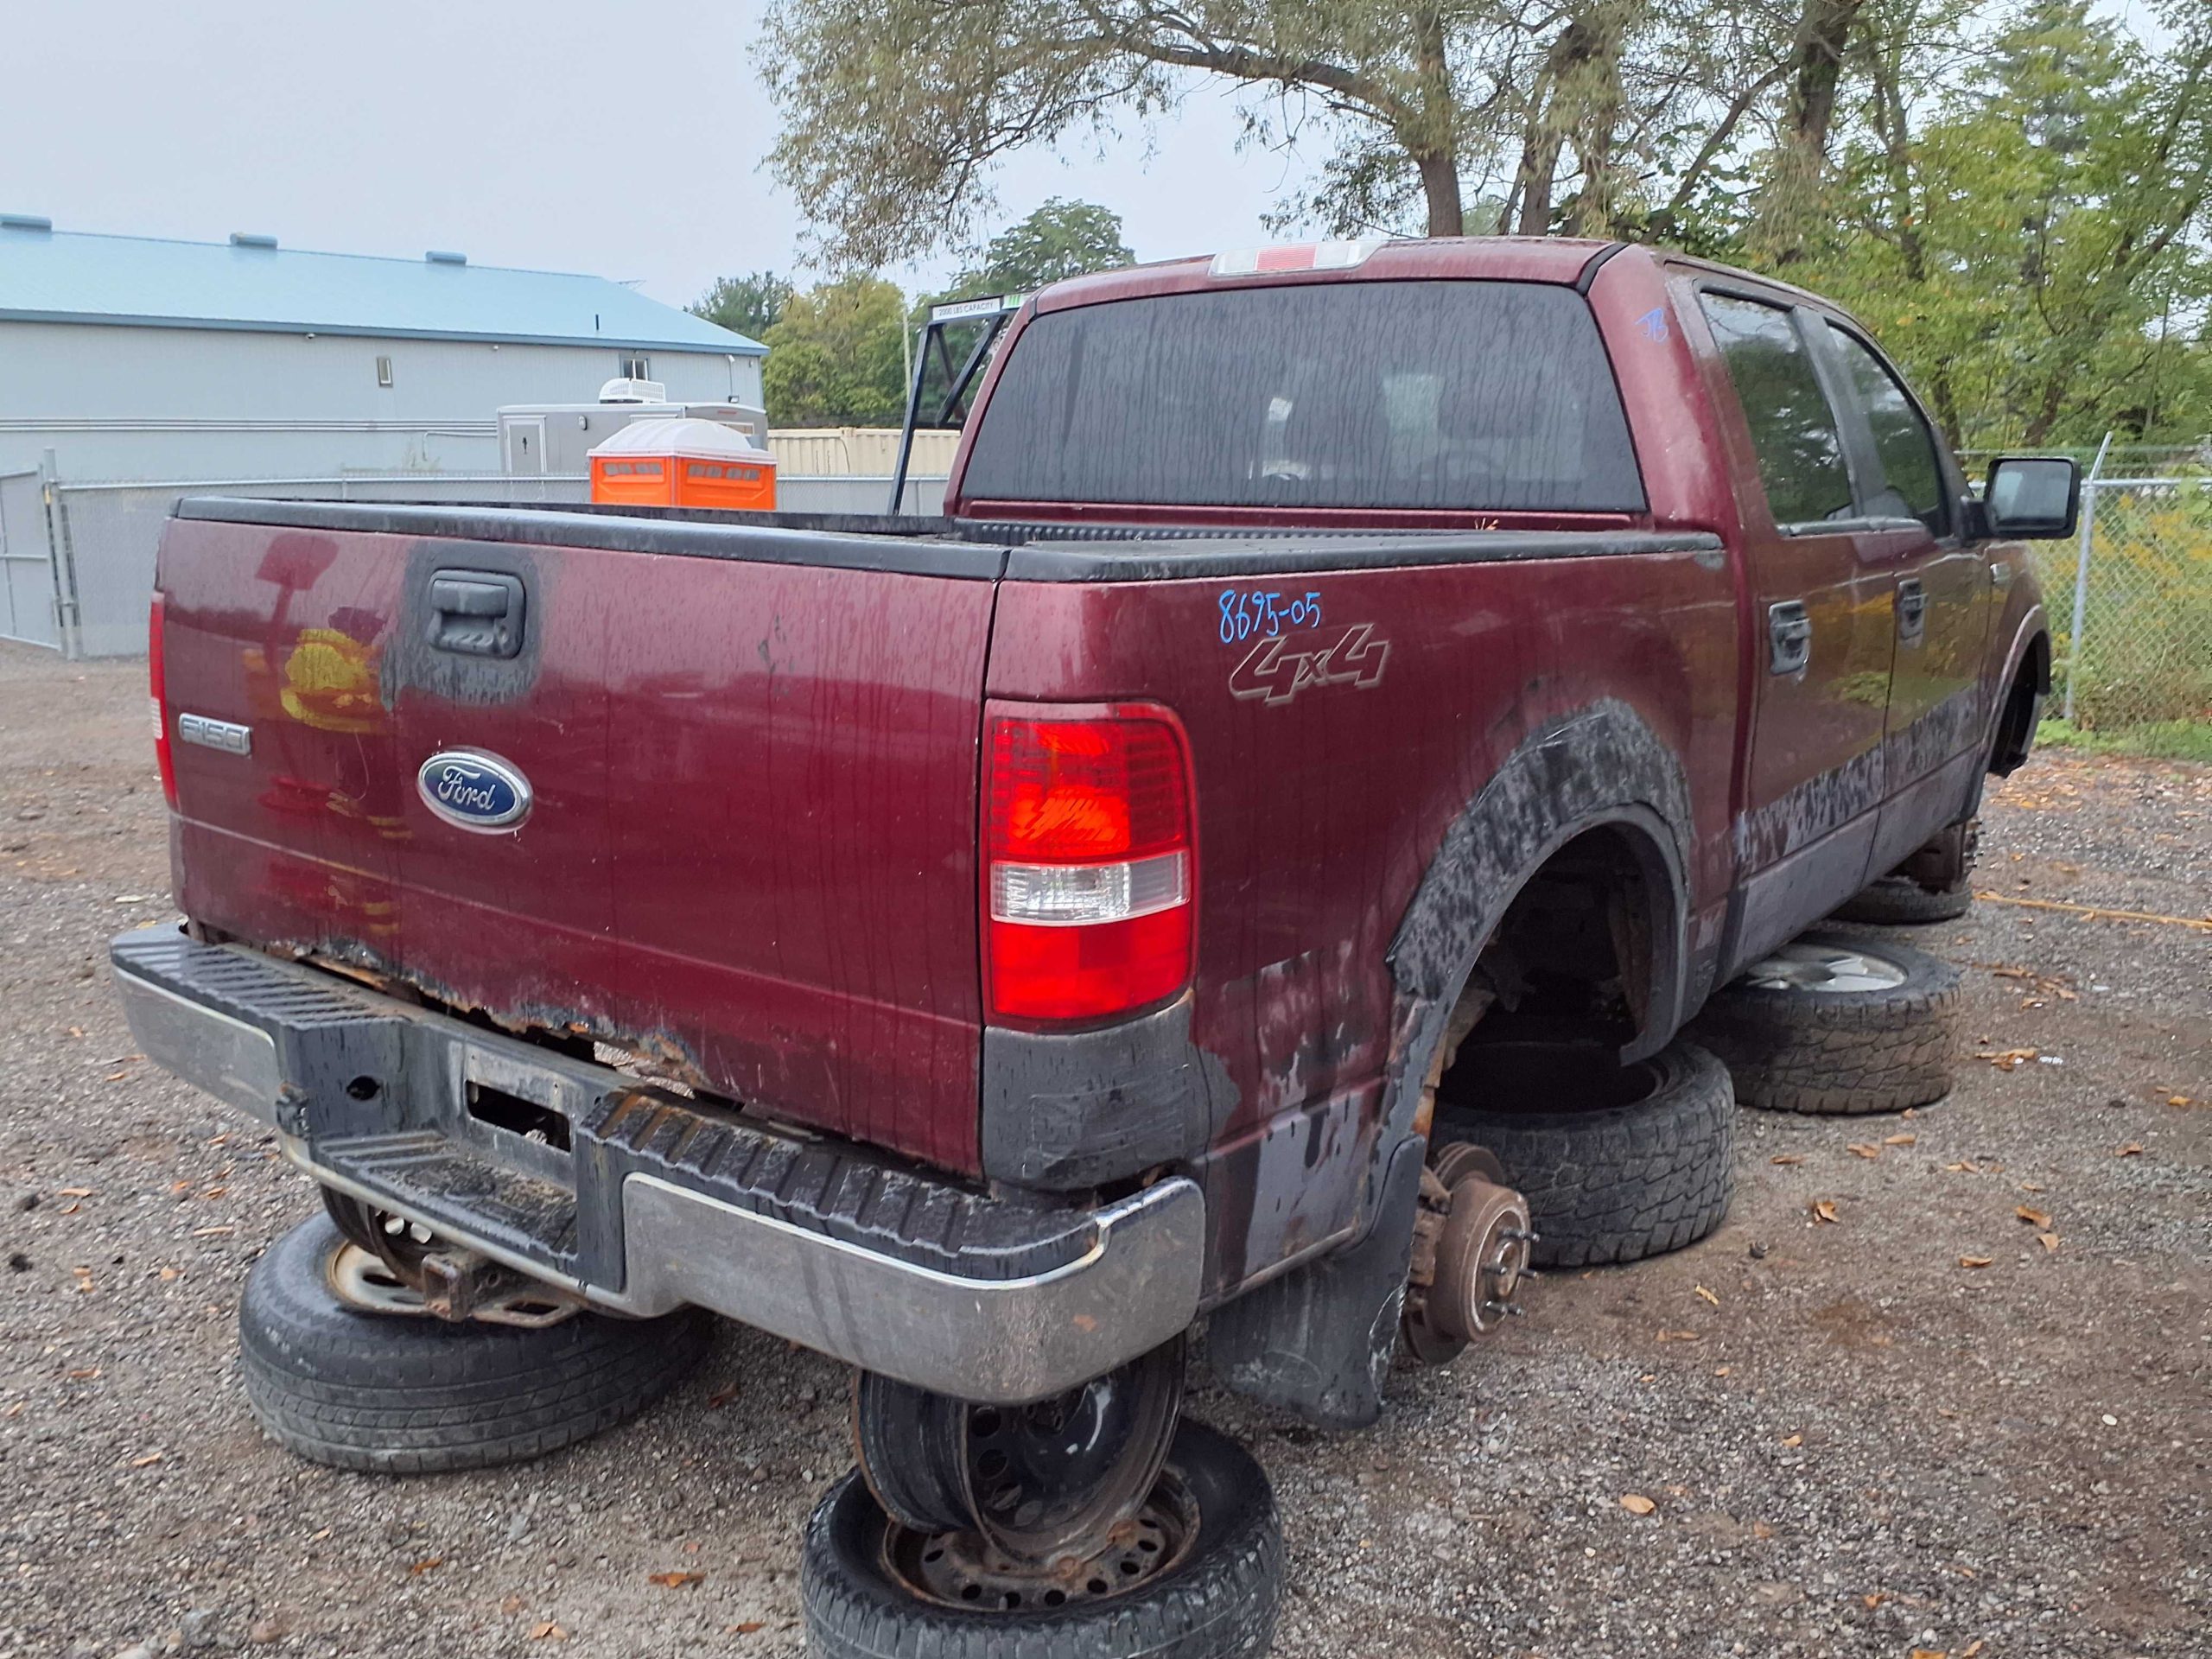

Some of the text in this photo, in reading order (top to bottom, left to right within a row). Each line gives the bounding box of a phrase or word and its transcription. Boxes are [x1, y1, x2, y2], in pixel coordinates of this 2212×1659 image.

[953, 304, 963, 315] LBS
[963, 301, 994, 312] CAPACITY
[1218, 589, 1321, 643] 8695-05
[437, 765, 496, 810] Ford
